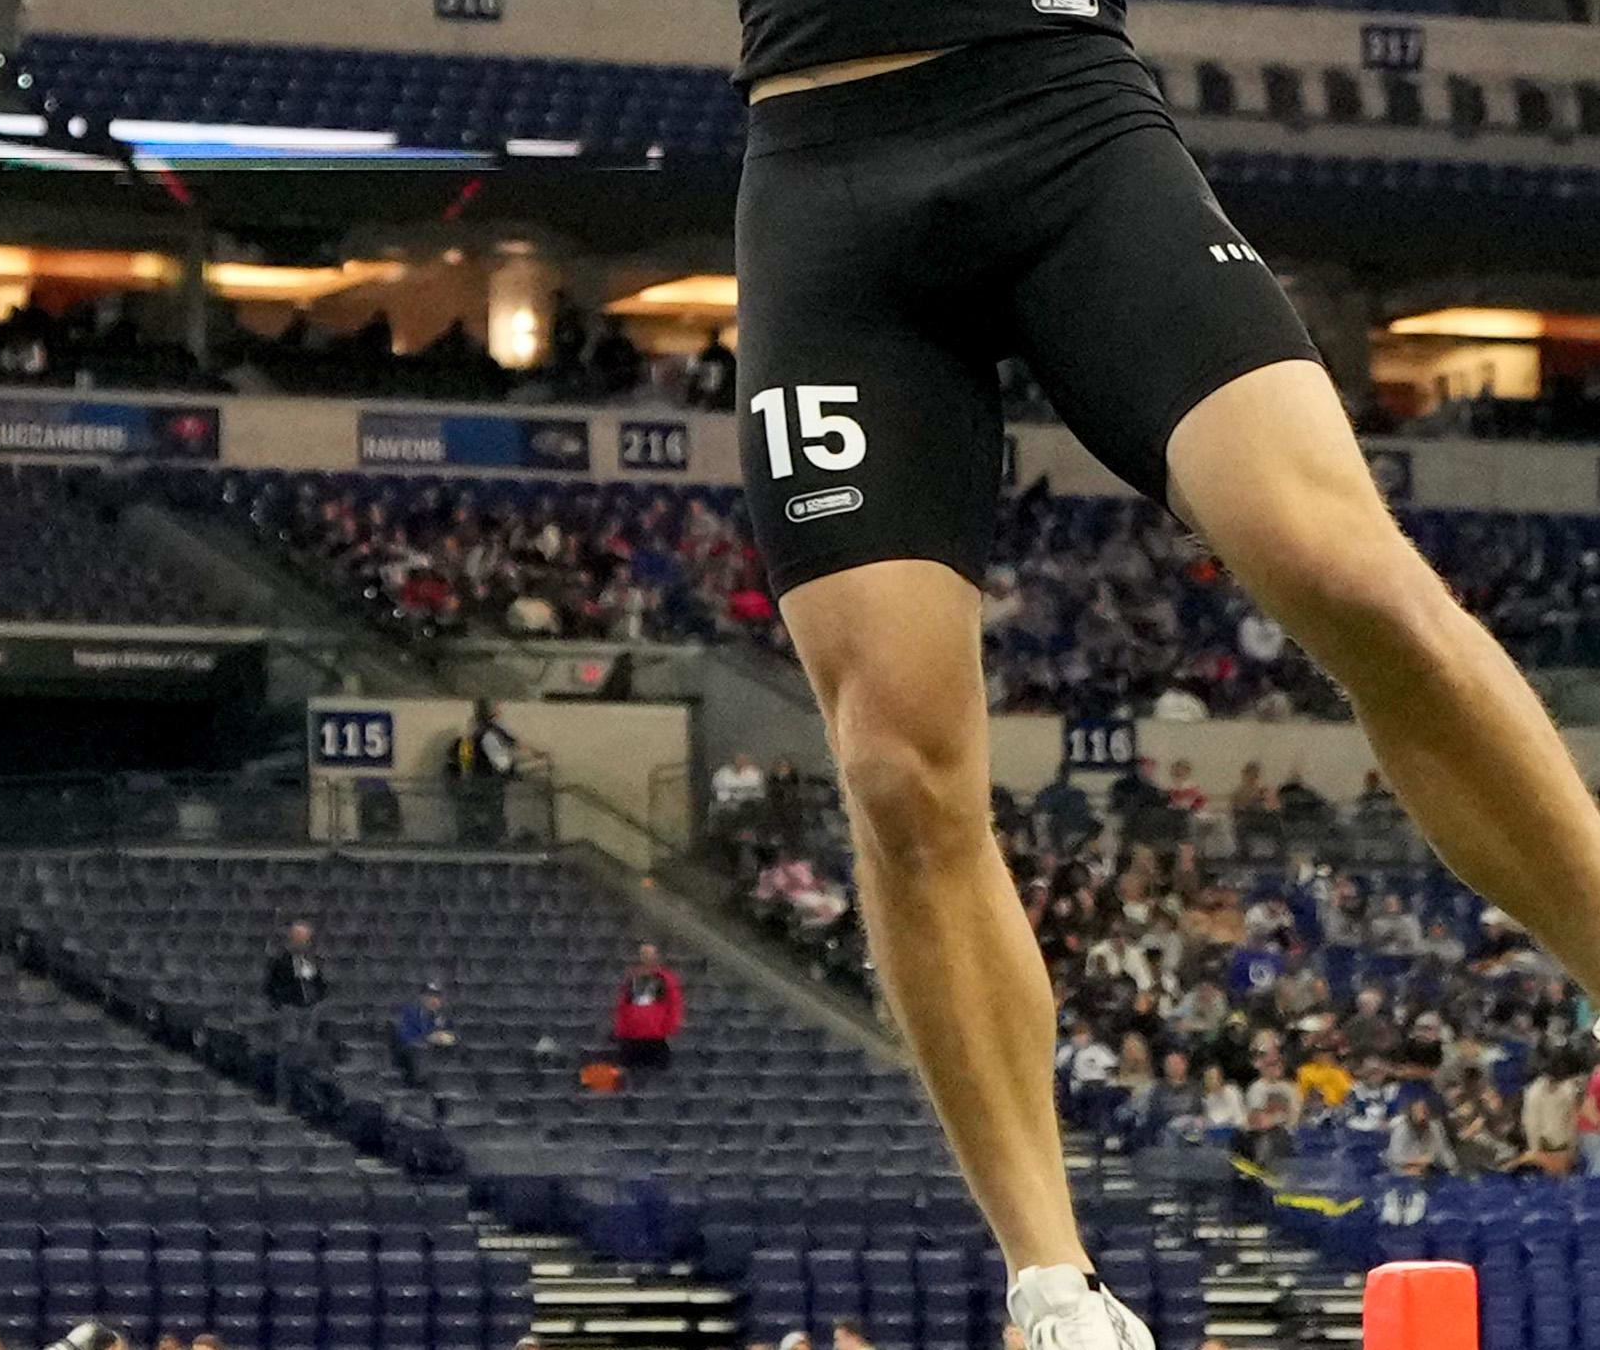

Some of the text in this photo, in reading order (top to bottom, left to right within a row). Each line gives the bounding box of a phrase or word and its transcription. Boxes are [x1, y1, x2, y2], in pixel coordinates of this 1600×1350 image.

[623, 429, 684, 464] 216
[751, 385, 867, 479] 15
[320, 721, 389, 757] 115
[1069, 726, 1132, 764] 116
